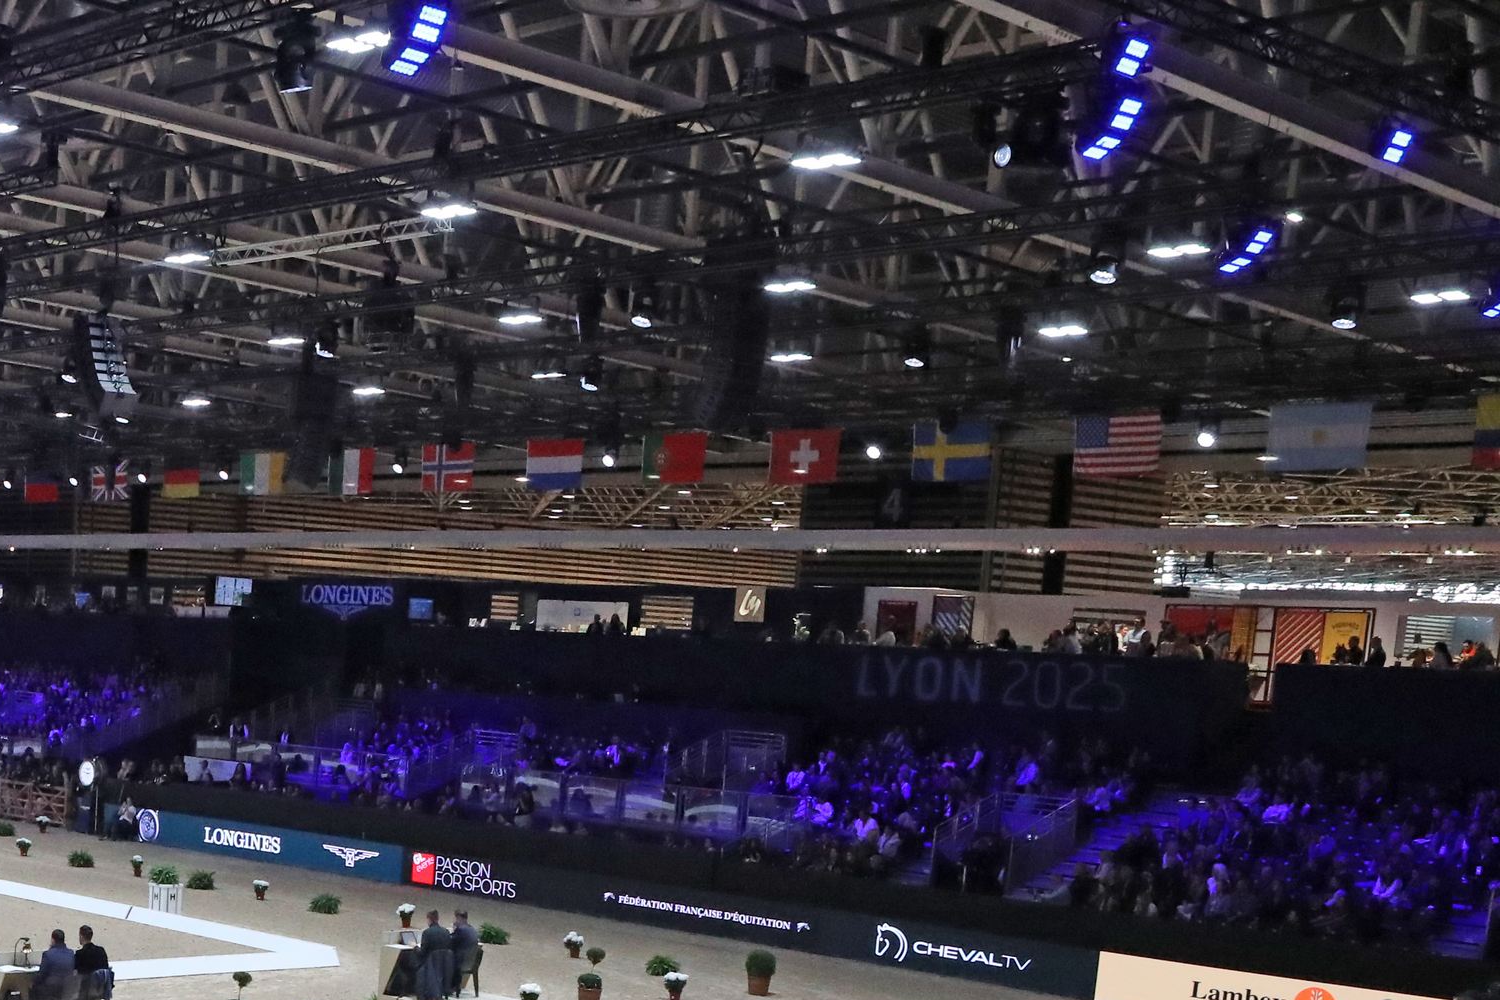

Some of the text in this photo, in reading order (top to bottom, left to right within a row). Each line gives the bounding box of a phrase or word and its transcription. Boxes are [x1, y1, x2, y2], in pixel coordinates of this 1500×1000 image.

[301, 584, 393, 606] LONGINES
[857, 656, 1126, 711] LYON 2025
[203, 826, 281, 854] LONGINES
[435, 855, 491, 879] PASSION
[170, 893, 176, 901] H
[434, 871, 516, 898] FOR SPORTS
[618, 895, 791, 930] FÉDÉRATION FRANÇAISE D'ÉQUITATION
